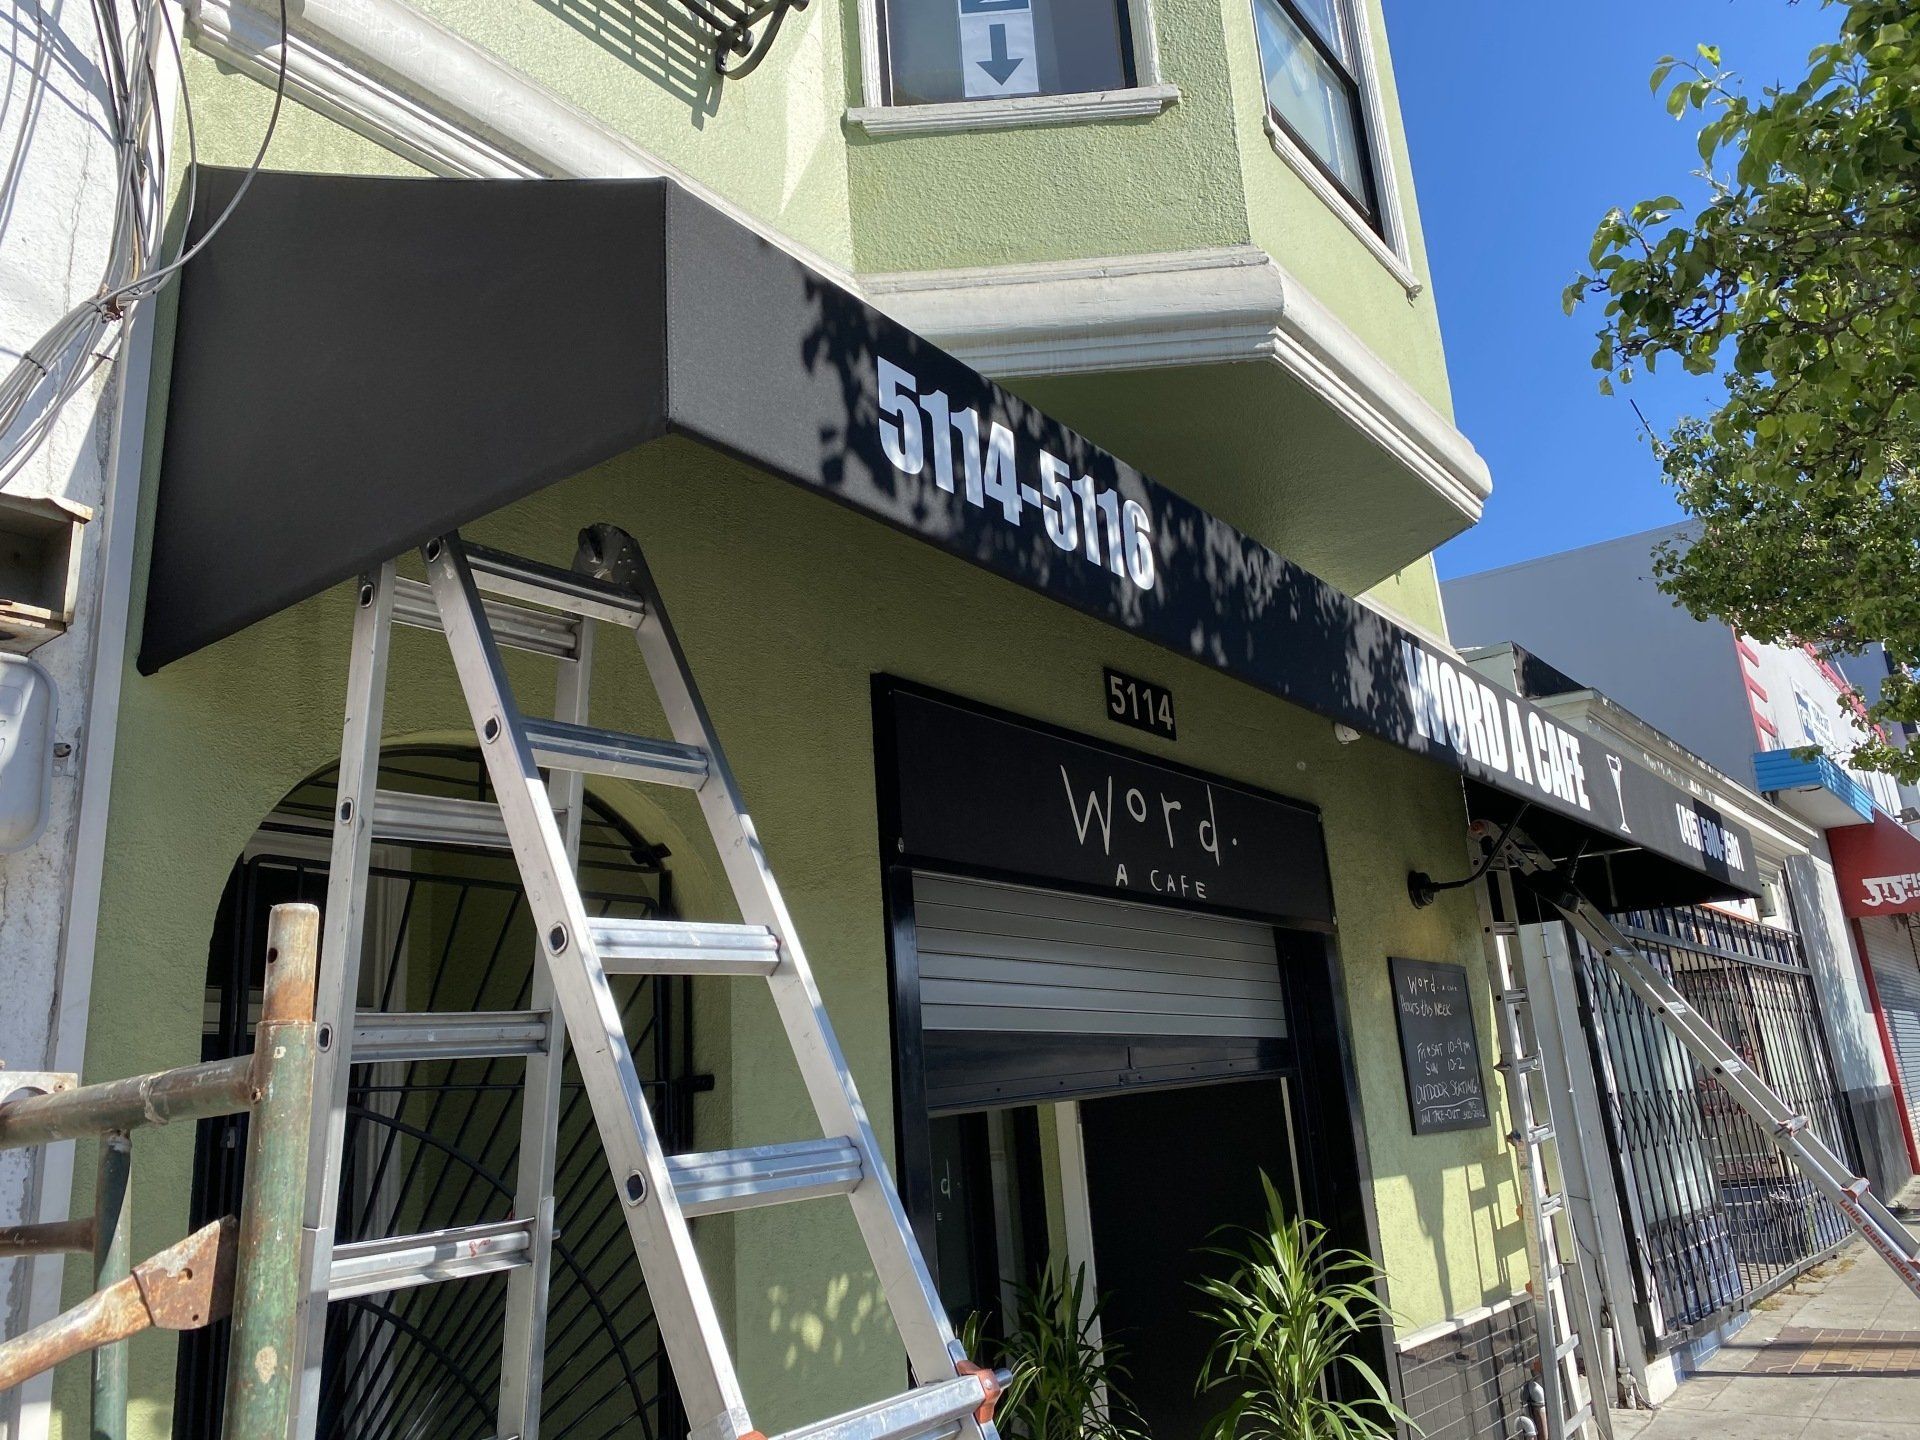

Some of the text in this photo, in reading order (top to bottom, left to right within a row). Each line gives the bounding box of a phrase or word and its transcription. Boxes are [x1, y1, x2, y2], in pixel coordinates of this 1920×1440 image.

[877, 355, 1155, 591] 5114-5116
[1109, 675, 1174, 731] 5114
[1400, 639, 1591, 812] WORD A CAFE
[1060, 763, 1240, 868] Word.
[1115, 863, 1208, 900] A CAFE
[1840, 1200, 1863, 1225] Little
[1863, 1224, 1888, 1251] Giant
